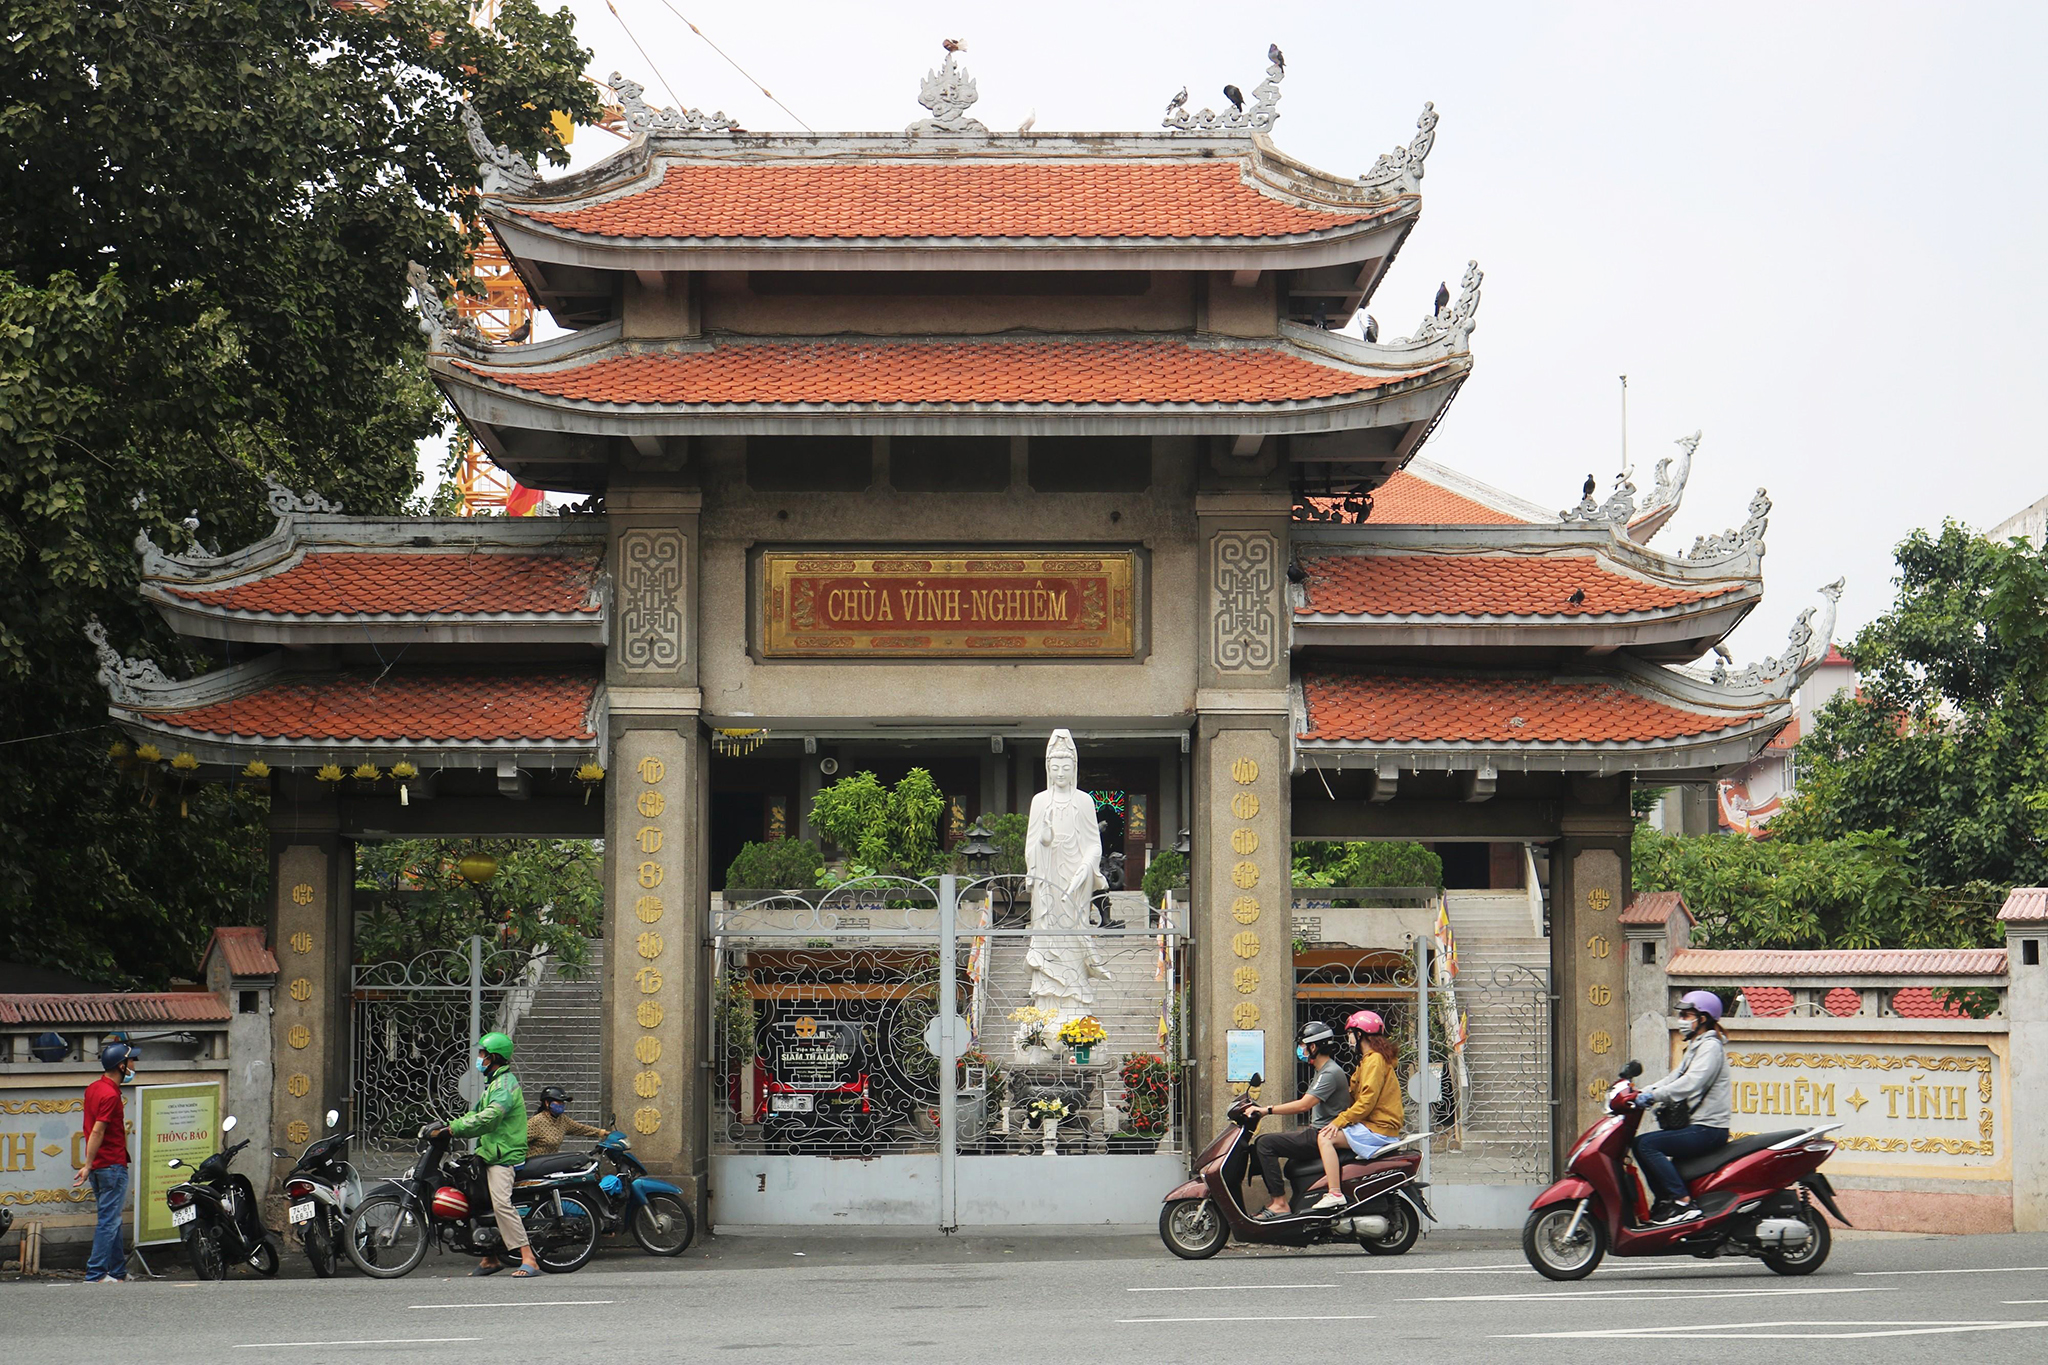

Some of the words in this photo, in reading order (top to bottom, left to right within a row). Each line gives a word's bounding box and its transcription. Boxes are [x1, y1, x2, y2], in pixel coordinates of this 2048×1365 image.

[827, 581, 894, 622] CHÙA
[901, 580, 1069, 622] VĨNH-NGHIÊM
[781, 1053, 803, 1061] SIAM
[805, 1053, 849, 1061] THAILAND
[157, 1130, 188, 1143] THÔNG
[189, 1128, 208, 1141] BÁO
